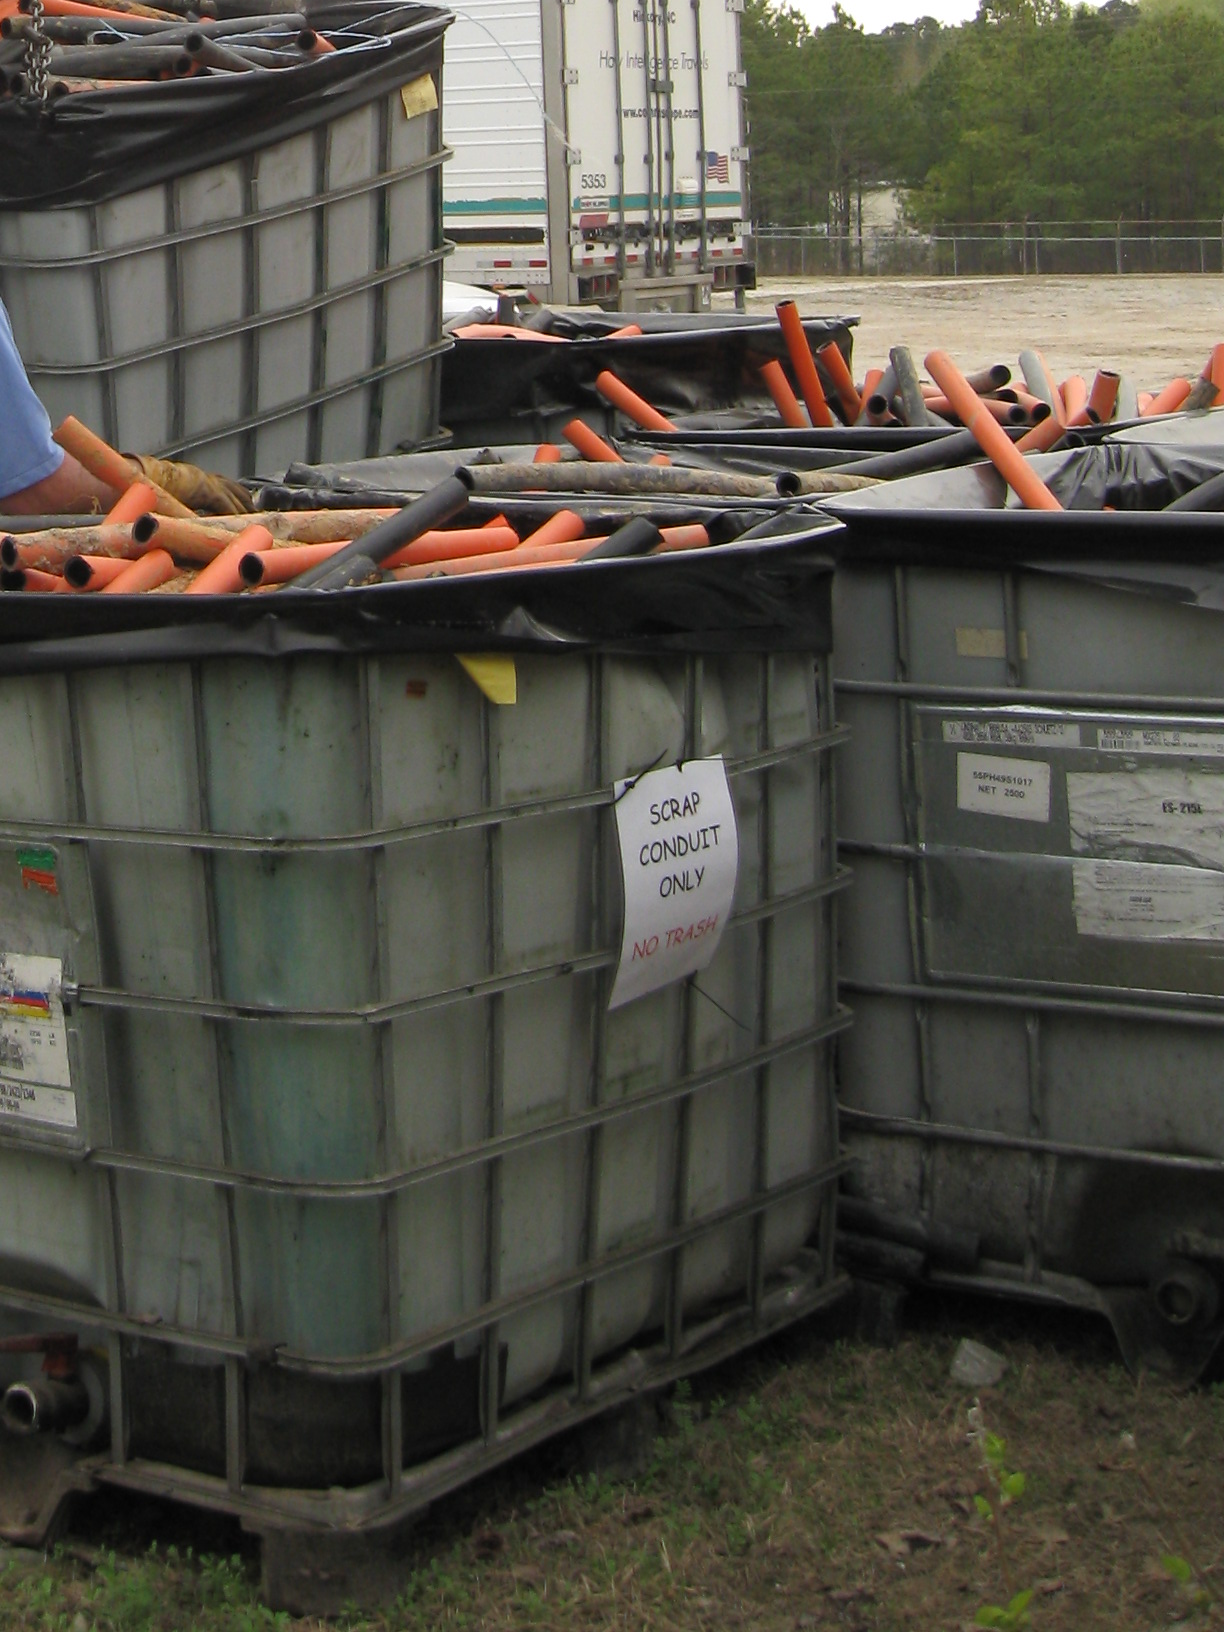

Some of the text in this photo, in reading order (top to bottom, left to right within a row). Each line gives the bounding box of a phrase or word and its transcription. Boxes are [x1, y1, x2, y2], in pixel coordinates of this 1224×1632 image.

[633, 10, 664, 27] Hikory,
[681, 52, 708, 70] Travls
[581, 174, 607, 189] 5353
[978, 784, 997, 795] NET
[649, 791, 700, 825] SCRAP
[639, 824, 721, 866] CONDUIT
[659, 866, 705, 898] ONLY
[631, 914, 719, 962] NO TRASH
